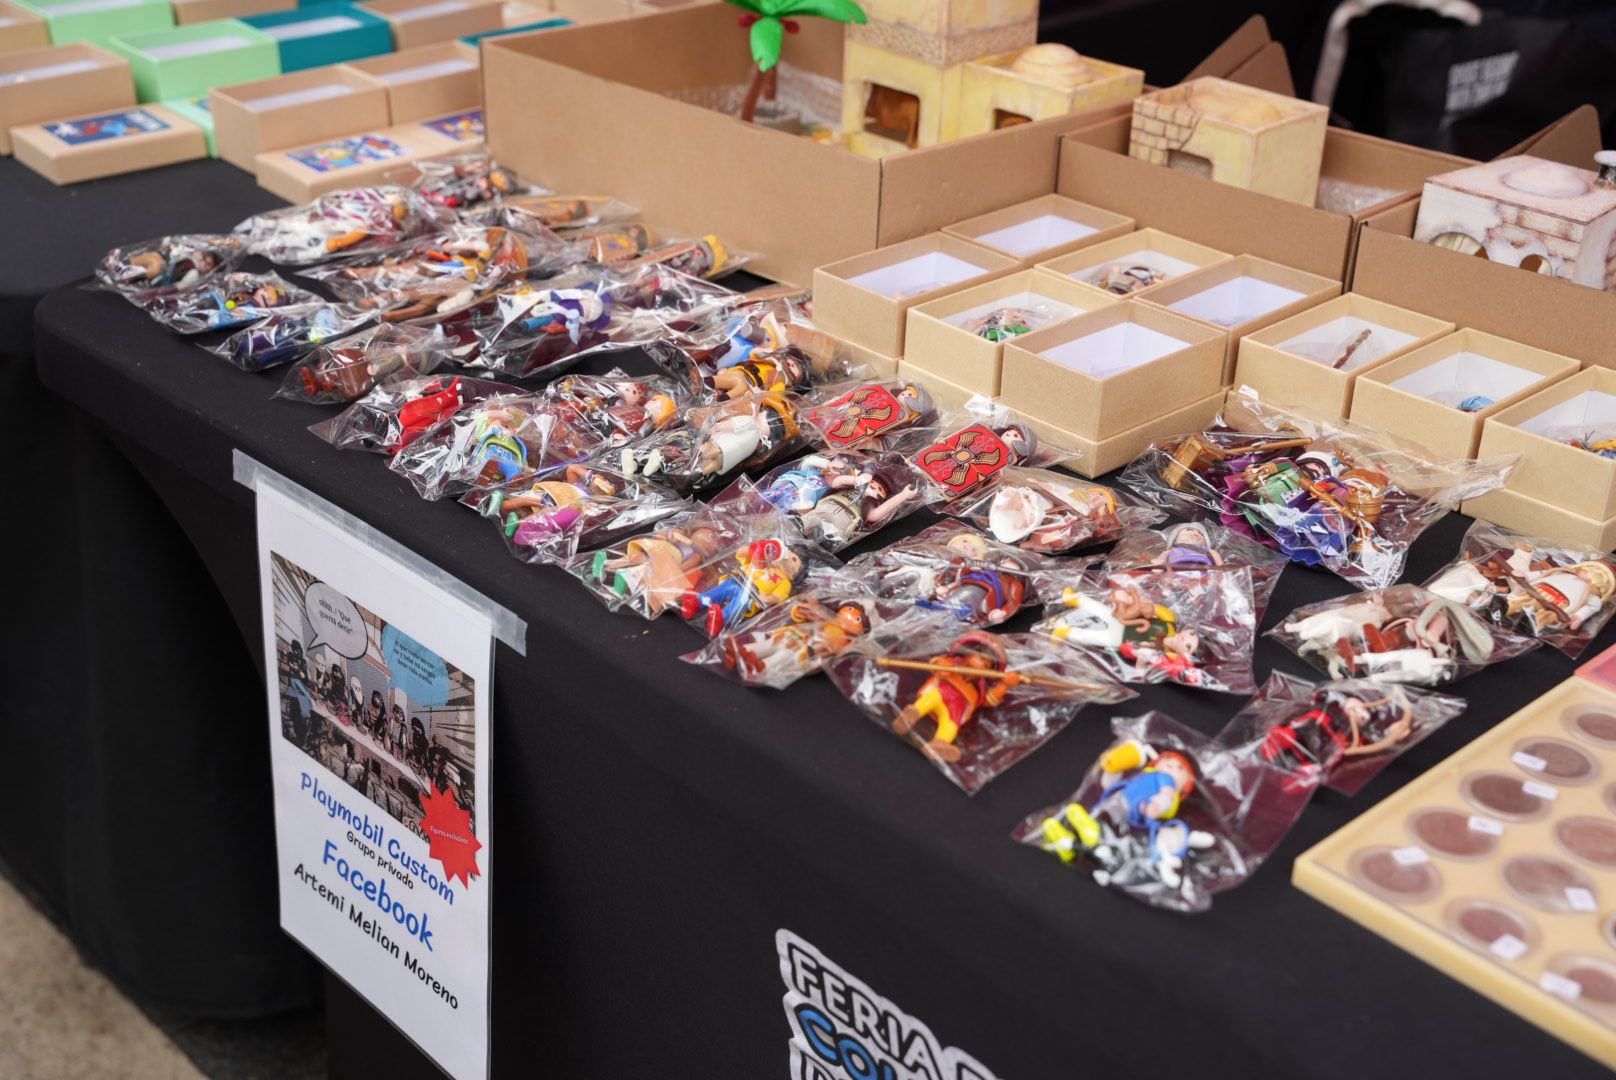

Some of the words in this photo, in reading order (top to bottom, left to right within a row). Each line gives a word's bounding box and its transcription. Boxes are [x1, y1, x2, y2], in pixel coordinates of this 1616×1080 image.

[301, 772, 384, 847] Playmobil
[388, 839, 454, 905] Custom
[323, 840, 433, 952] Facebook
[346, 831, 375, 859] Grupo
[378, 856, 414, 890] privado
[294, 863, 345, 912] Artemi
[350, 904, 399, 958] Melian
[404, 951, 459, 1009] Moreno
[788, 943, 942, 1080] FERIA
